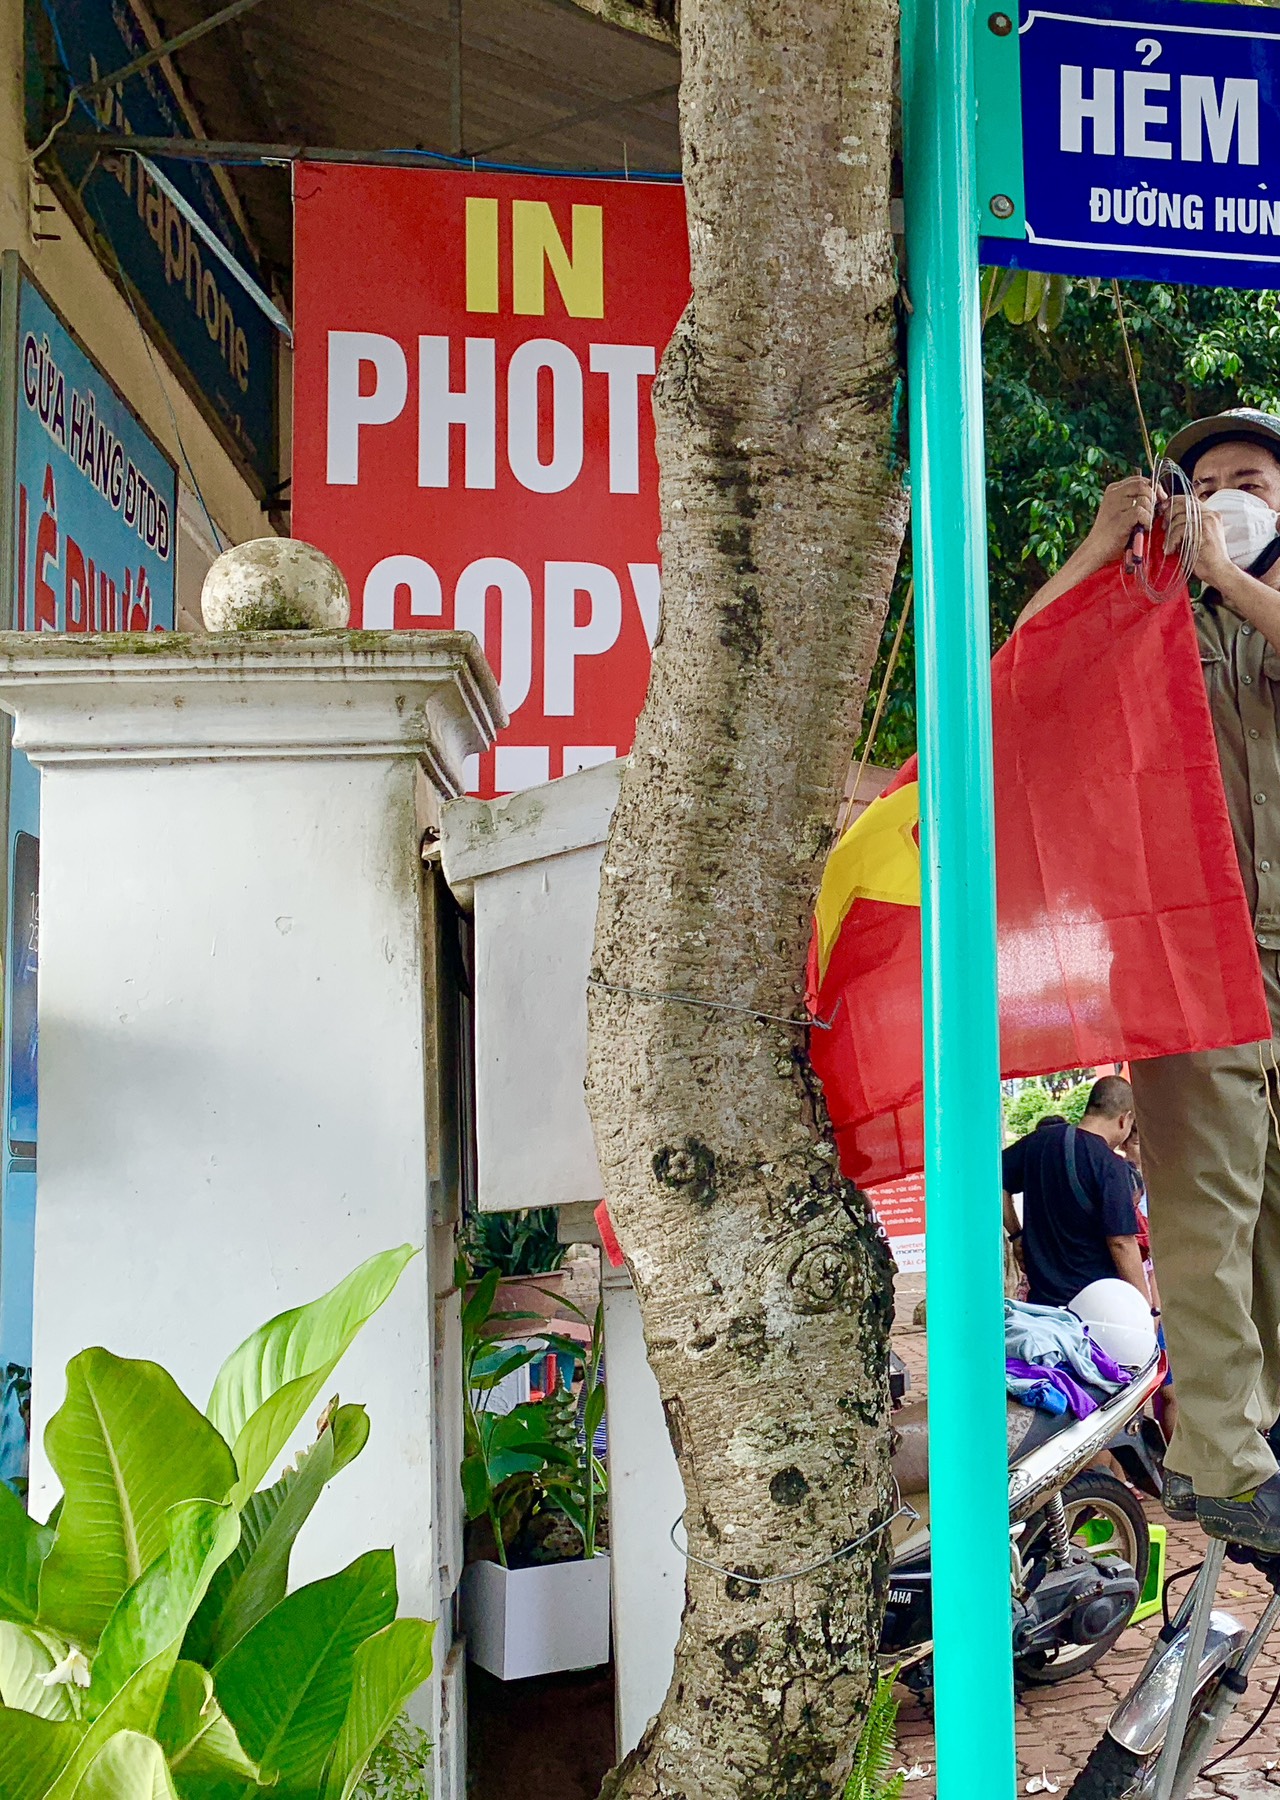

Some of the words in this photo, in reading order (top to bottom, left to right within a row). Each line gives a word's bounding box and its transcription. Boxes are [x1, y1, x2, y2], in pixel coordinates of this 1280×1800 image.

[1060, 38, 1260, 167] HẺM
[465, 197, 604, 319] IN
[1088, 180, 1205, 231] ĐƯỜNG
[22, 331, 67, 452] CỬA
[68, 386, 125, 512] HÀNG
[326, 330, 657, 495] PHOT
